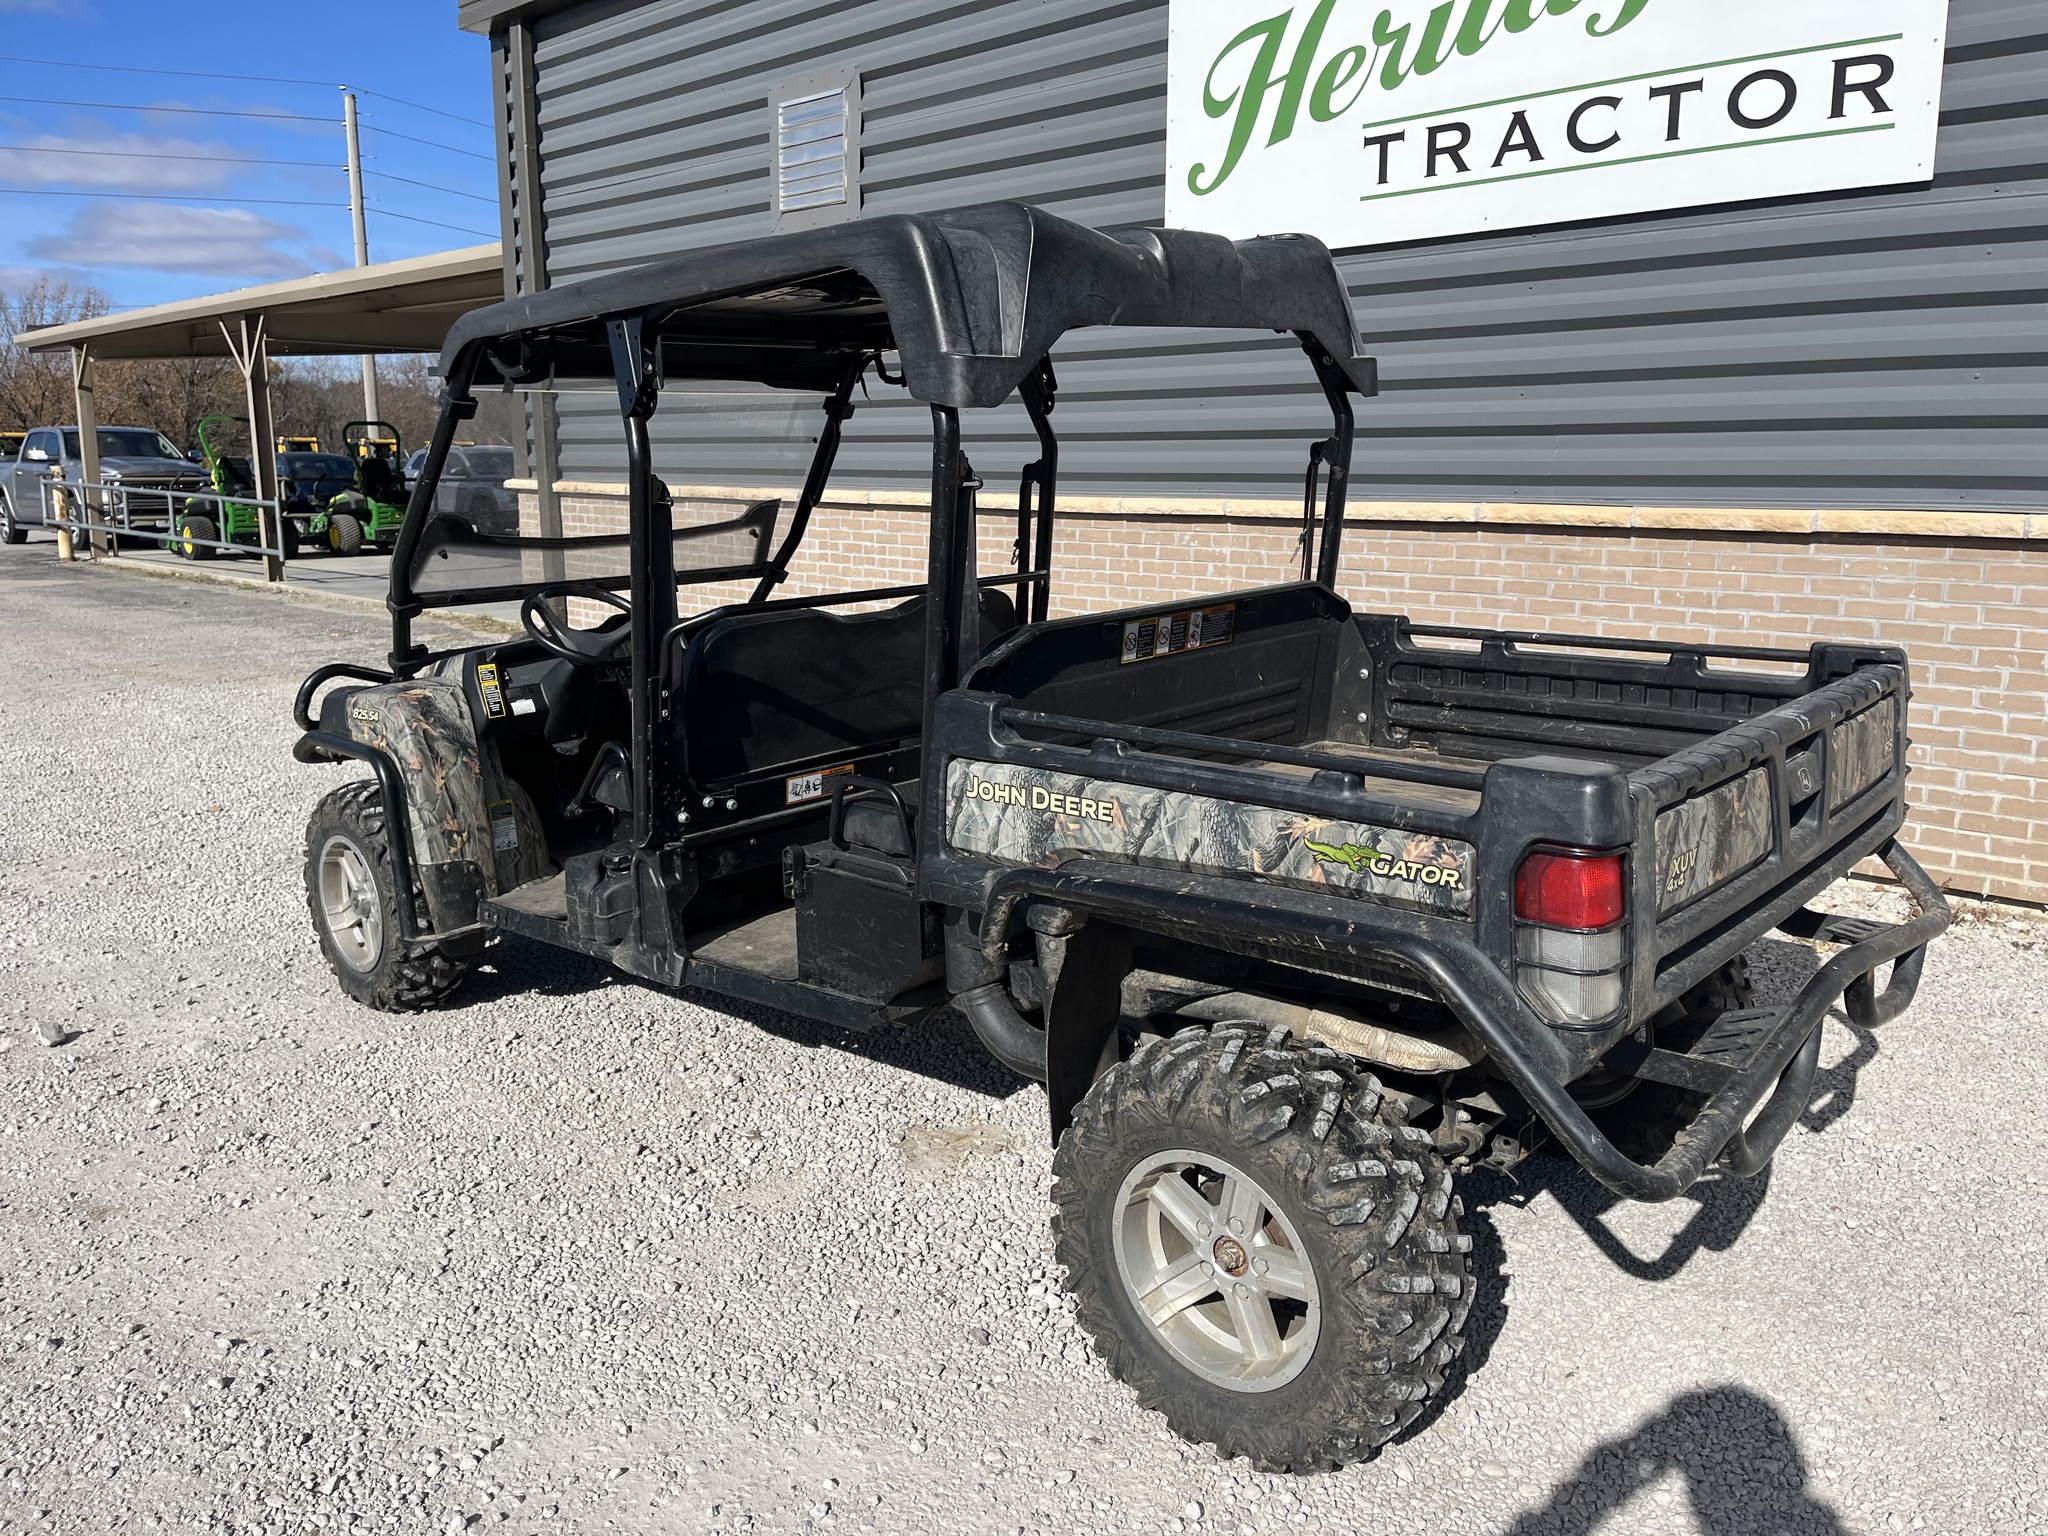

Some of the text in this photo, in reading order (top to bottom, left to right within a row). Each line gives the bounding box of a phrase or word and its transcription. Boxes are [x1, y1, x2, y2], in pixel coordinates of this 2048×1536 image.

[1364, 54, 1895, 186] TRACTOR
[369, 710, 379, 722] S4
[966, 776, 1114, 822] JOHN DEERE
[1369, 852, 1461, 890] GATOR
[1671, 847, 1698, 878] XUV
[1666, 872, 1685, 892] 4x4
